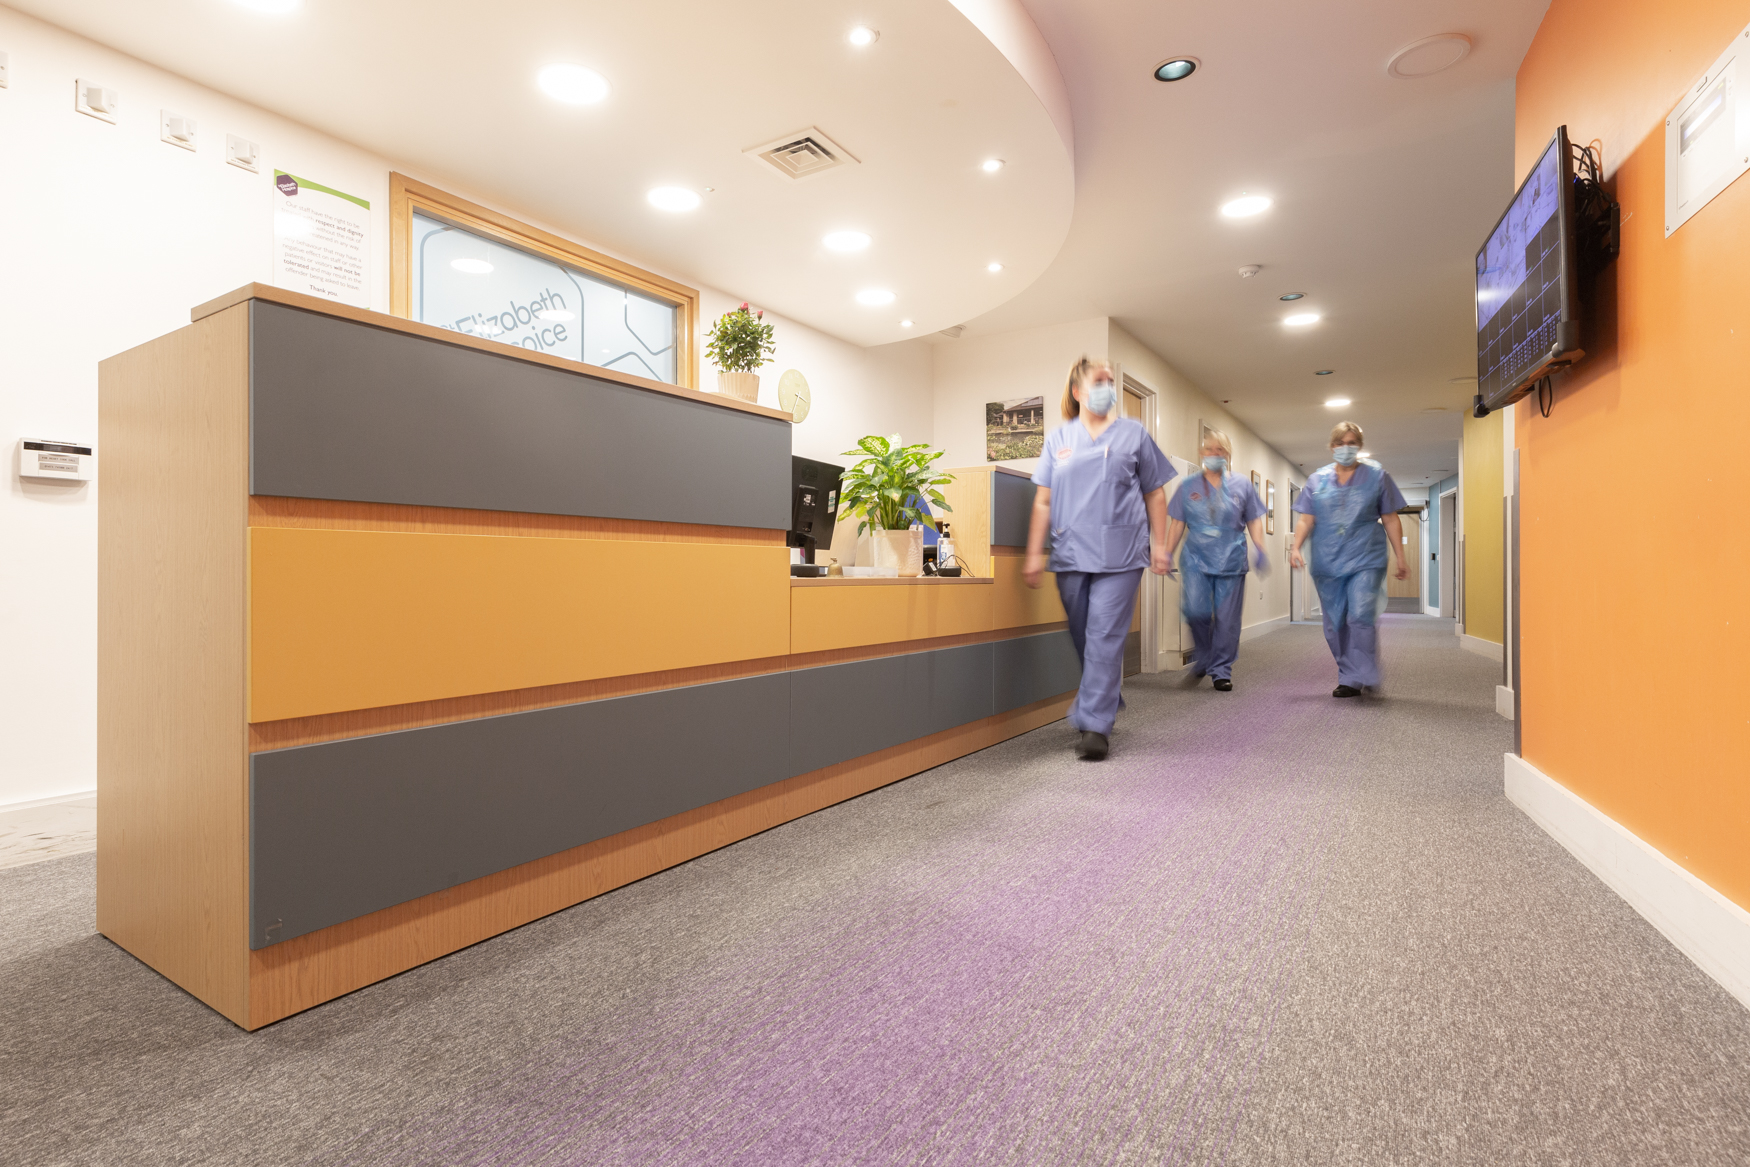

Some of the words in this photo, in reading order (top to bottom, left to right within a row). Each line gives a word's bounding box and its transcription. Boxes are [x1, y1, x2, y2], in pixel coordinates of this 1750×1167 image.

[315, 219, 335, 228] respect
[347, 229, 364, 238] dignity
[316, 227, 335, 235] without
[282, 244, 305, 253] negative
[306, 250, 321, 258] effect
[296, 240, 322, 250] behaviour
[284, 259, 310, 270] tolerated
[285, 252, 306, 262] patients
[315, 260, 332, 269] visitors
[285, 267, 308, 277] offender
[310, 273, 324, 282] being
[309, 284, 326, 293] Thank
